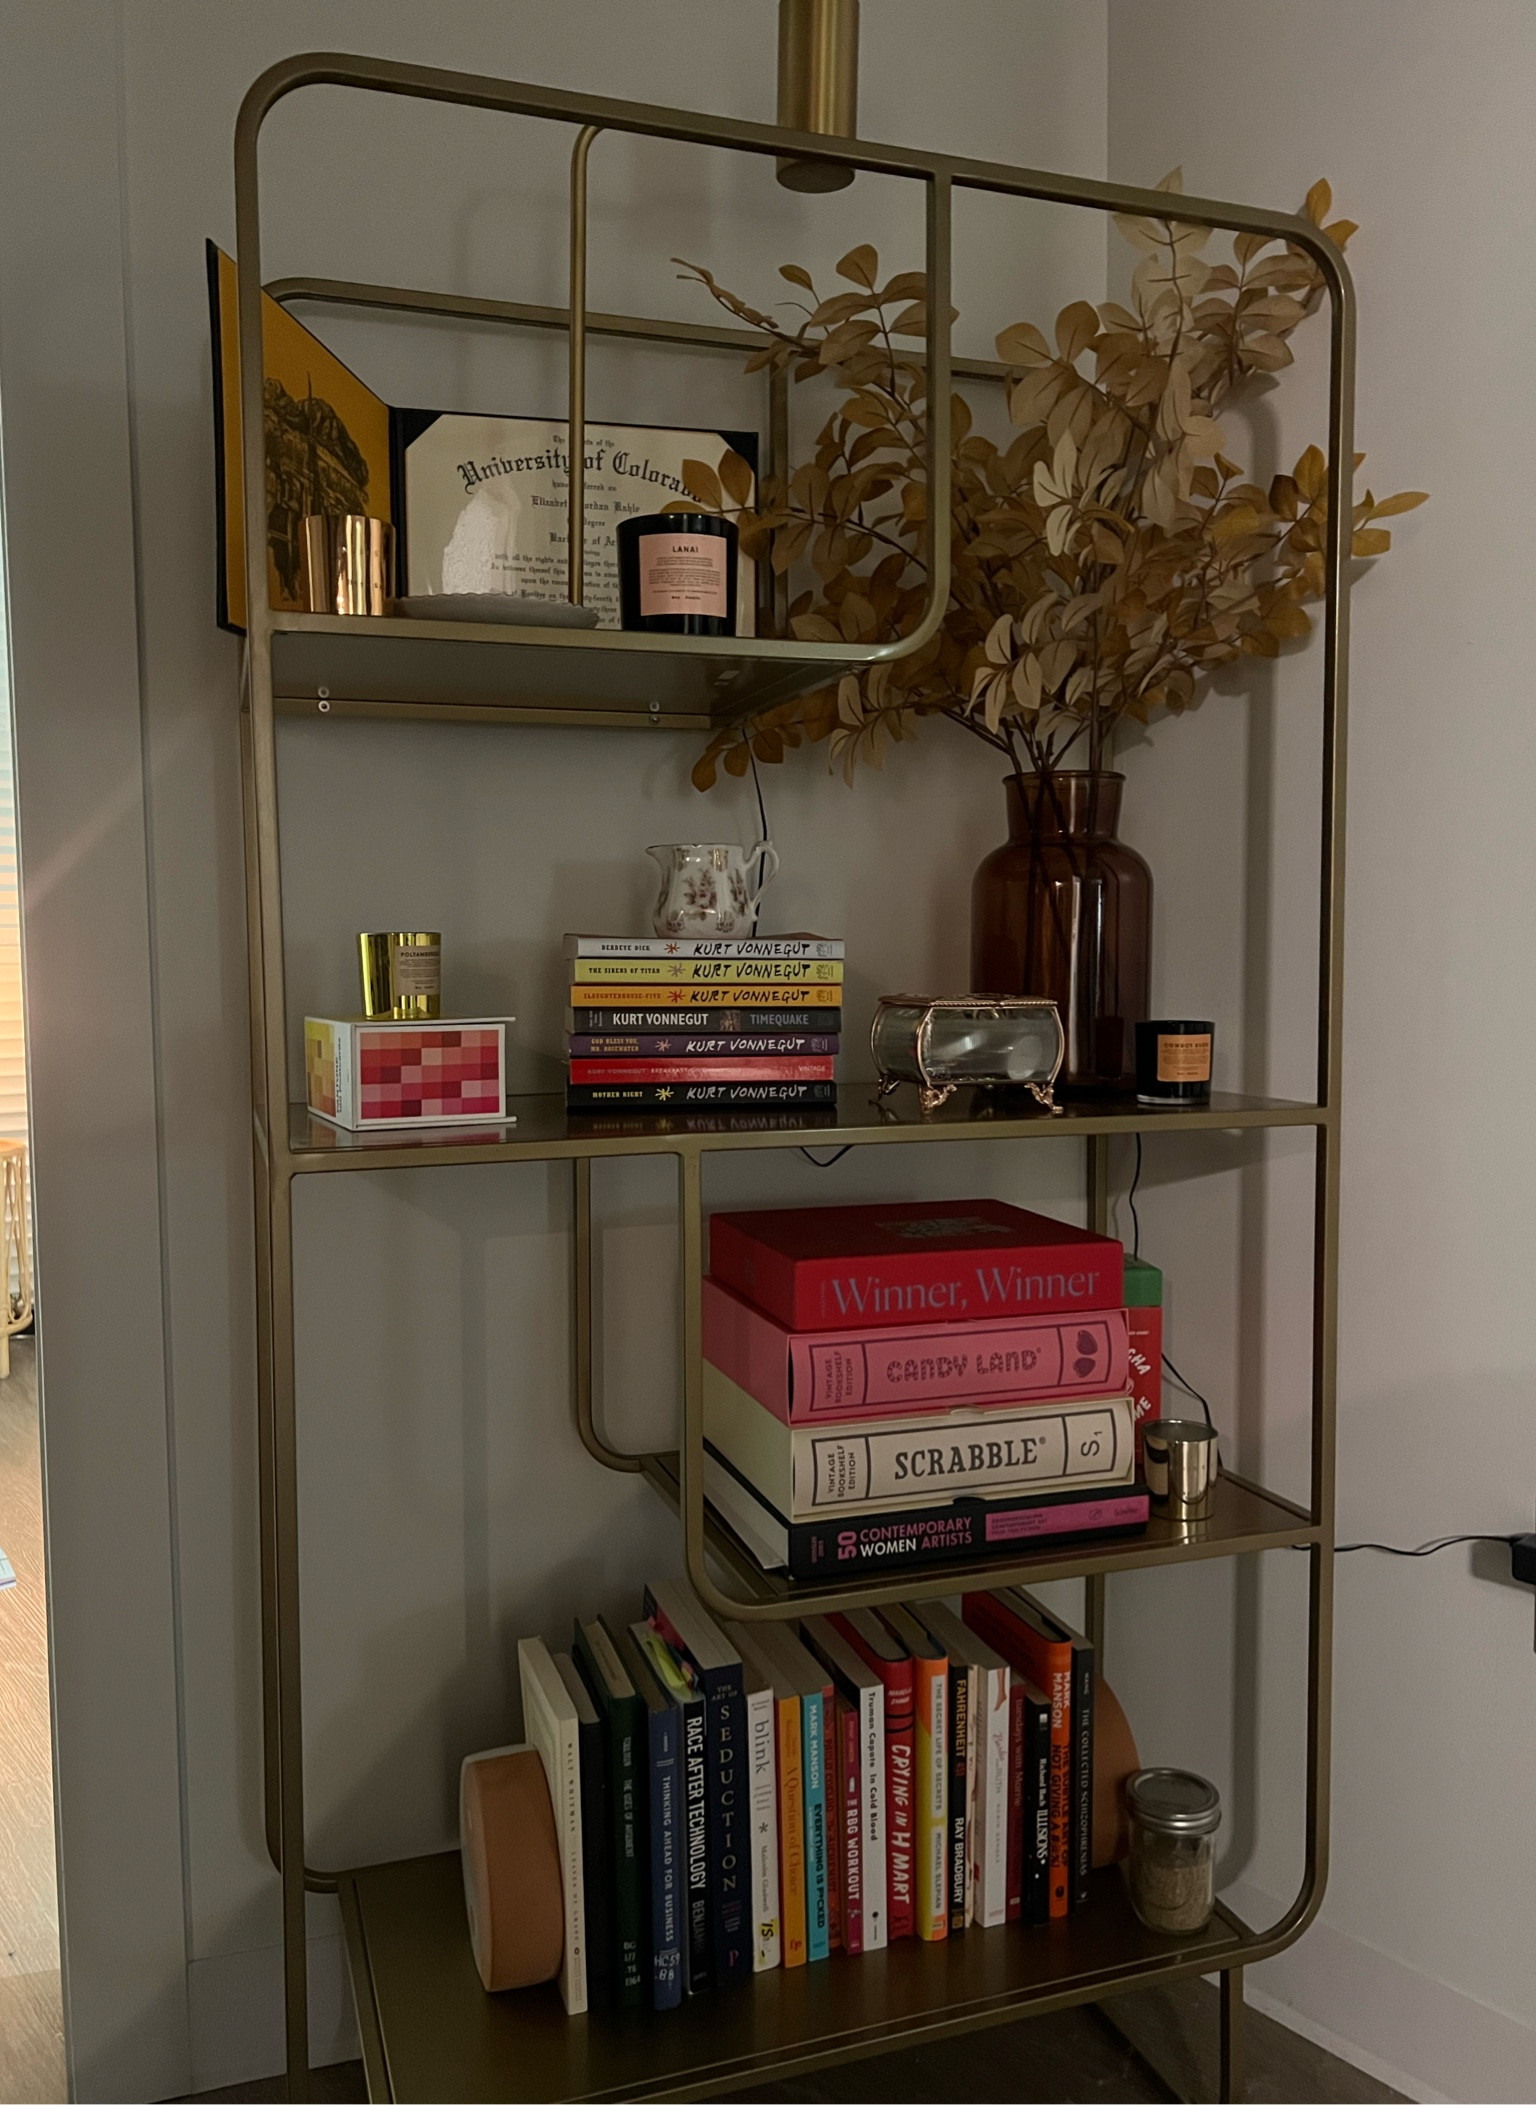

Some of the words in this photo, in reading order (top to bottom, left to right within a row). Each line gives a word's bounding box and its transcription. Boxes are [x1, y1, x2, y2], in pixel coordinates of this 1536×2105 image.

[456, 447, 570, 495] University
[584, 449, 606, 471] of
[530, 495, 568, 510] Elizabet
[584, 501, 609, 511] ordan
[693, 943, 732, 955] KURT
[736, 942, 810, 957] VONNEGUT
[692, 963, 731, 979] KURT
[736, 961, 811, 980] VONNEGUT
[690, 990, 730, 1002] KURT
[733, 989, 810, 1004] VONNEGUT
[613, 1013, 644, 1025] KURT
[646, 1013, 709, 1025] VONNEGUT
[750, 1014, 809, 1026] TIMEQUAKE
[686, 1040, 726, 1053] KURT
[730, 1037, 805, 1052] VONNEGUT
[686, 1086, 726, 1099] KURT
[730, 1084, 807, 1099] VONNEGUT
[832, 1276, 968, 1315] Winner,
[975, 1266, 1100, 1303] Winner
[825, 1359, 833, 1400] VINTAGE
[834, 1350, 842, 1403] BOOKSHELF
[845, 1358, 853, 1396] EDITION
[887, 1354, 968, 1383] CANDY
[976, 1349, 1038, 1374] LAND
[827, 1453, 835, 1494] VINTAGE
[837, 1444, 845, 1498] BOOKSHELF
[848, 1452, 856, 1490] EDITION
[894, 1437, 1038, 1481] SCRABBLE
[837, 1530, 857, 1560] 50
[860, 1516, 972, 1542] CONTEMPORARY
[860, 1537, 917, 1558] WOMEN
[921, 1531, 972, 1550] ARTISTS
[712, 1691, 726, 1701] ART
[728, 1690, 738, 1698] OF
[717, 1684, 733, 1693] THE
[1052, 1672, 1063, 1728] MANSON
[1063, 1671, 1071, 1709] MARK
[809, 1704, 818, 1738] MARK
[868, 1692, 876, 1729] Truman
[955, 1679, 967, 1758] FAHRENHEIT
[1081, 1708, 1090, 1727] THE
[687, 1716, 703, 1755] RACE
[754, 1719, 770, 1775] blink
[867, 1733, 876, 1768] Capote
[810, 1740, 819, 1789] MANSON
[935, 1756, 942, 1769] OF
[1014, 1745, 1024, 1768] with
[1039, 1758, 1047, 1787] Richard
[1052, 1744, 1062, 1770] NOT
[1081, 1730, 1090, 1788] COLLECTED
[623, 1778, 633, 1792] THE
[688, 1757, 704, 1800] AFTER
[869, 1774, 877, 1784] In
[891, 1744, 911, 1806] CRYING
[1014, 1771, 1024, 1807] Morrie
[568, 1779, 576, 1832] WHITMAN
[662, 1776, 671, 1826] THINKING
[719, 1705, 738, 1892] SEDUCTION
[784, 1777, 800, 1833] Question
[1039, 1788, 1047, 1807] Bach
[1051, 1774, 1061, 1818] GIVING
[624, 1811, 633, 1820] OF
[847, 1809, 858, 1834] RBG
[870, 1812, 878, 1841] Blood
[894, 1811, 908, 1828] IN
[953, 1817, 965, 1837] RAY
[1079, 1791, 1089, 1876] SCHIZOPHRENIAS
[663, 1830, 672, 1865] AHEAD
[689, 1801, 706, 1890] TECHNOLOGY
[788, 1837, 800, 1849] of
[814, 1803, 824, 1871] EVERYTHING
[891, 1831, 911, 1848] H
[1037, 1809, 1048, 1859] ILLUSIONS
[570, 1851, 578, 1888] LEAVES
[761, 1845, 769, 1878] Malcolm
[847, 1837, 859, 1900] WORKOUT
[934, 1832, 942, 1873] MICHAEL
[664, 1868, 673, 1890] FOR
[788, 1851, 801, 1897] Choice
[816, 1875, 825, 1884] IS
[891, 1852, 910, 1904] MART
[953, 1842, 965, 1904] BRADBURY
[762, 1879, 770, 1913] Gladwell
[665, 1894, 674, 1942] BUSINESS
